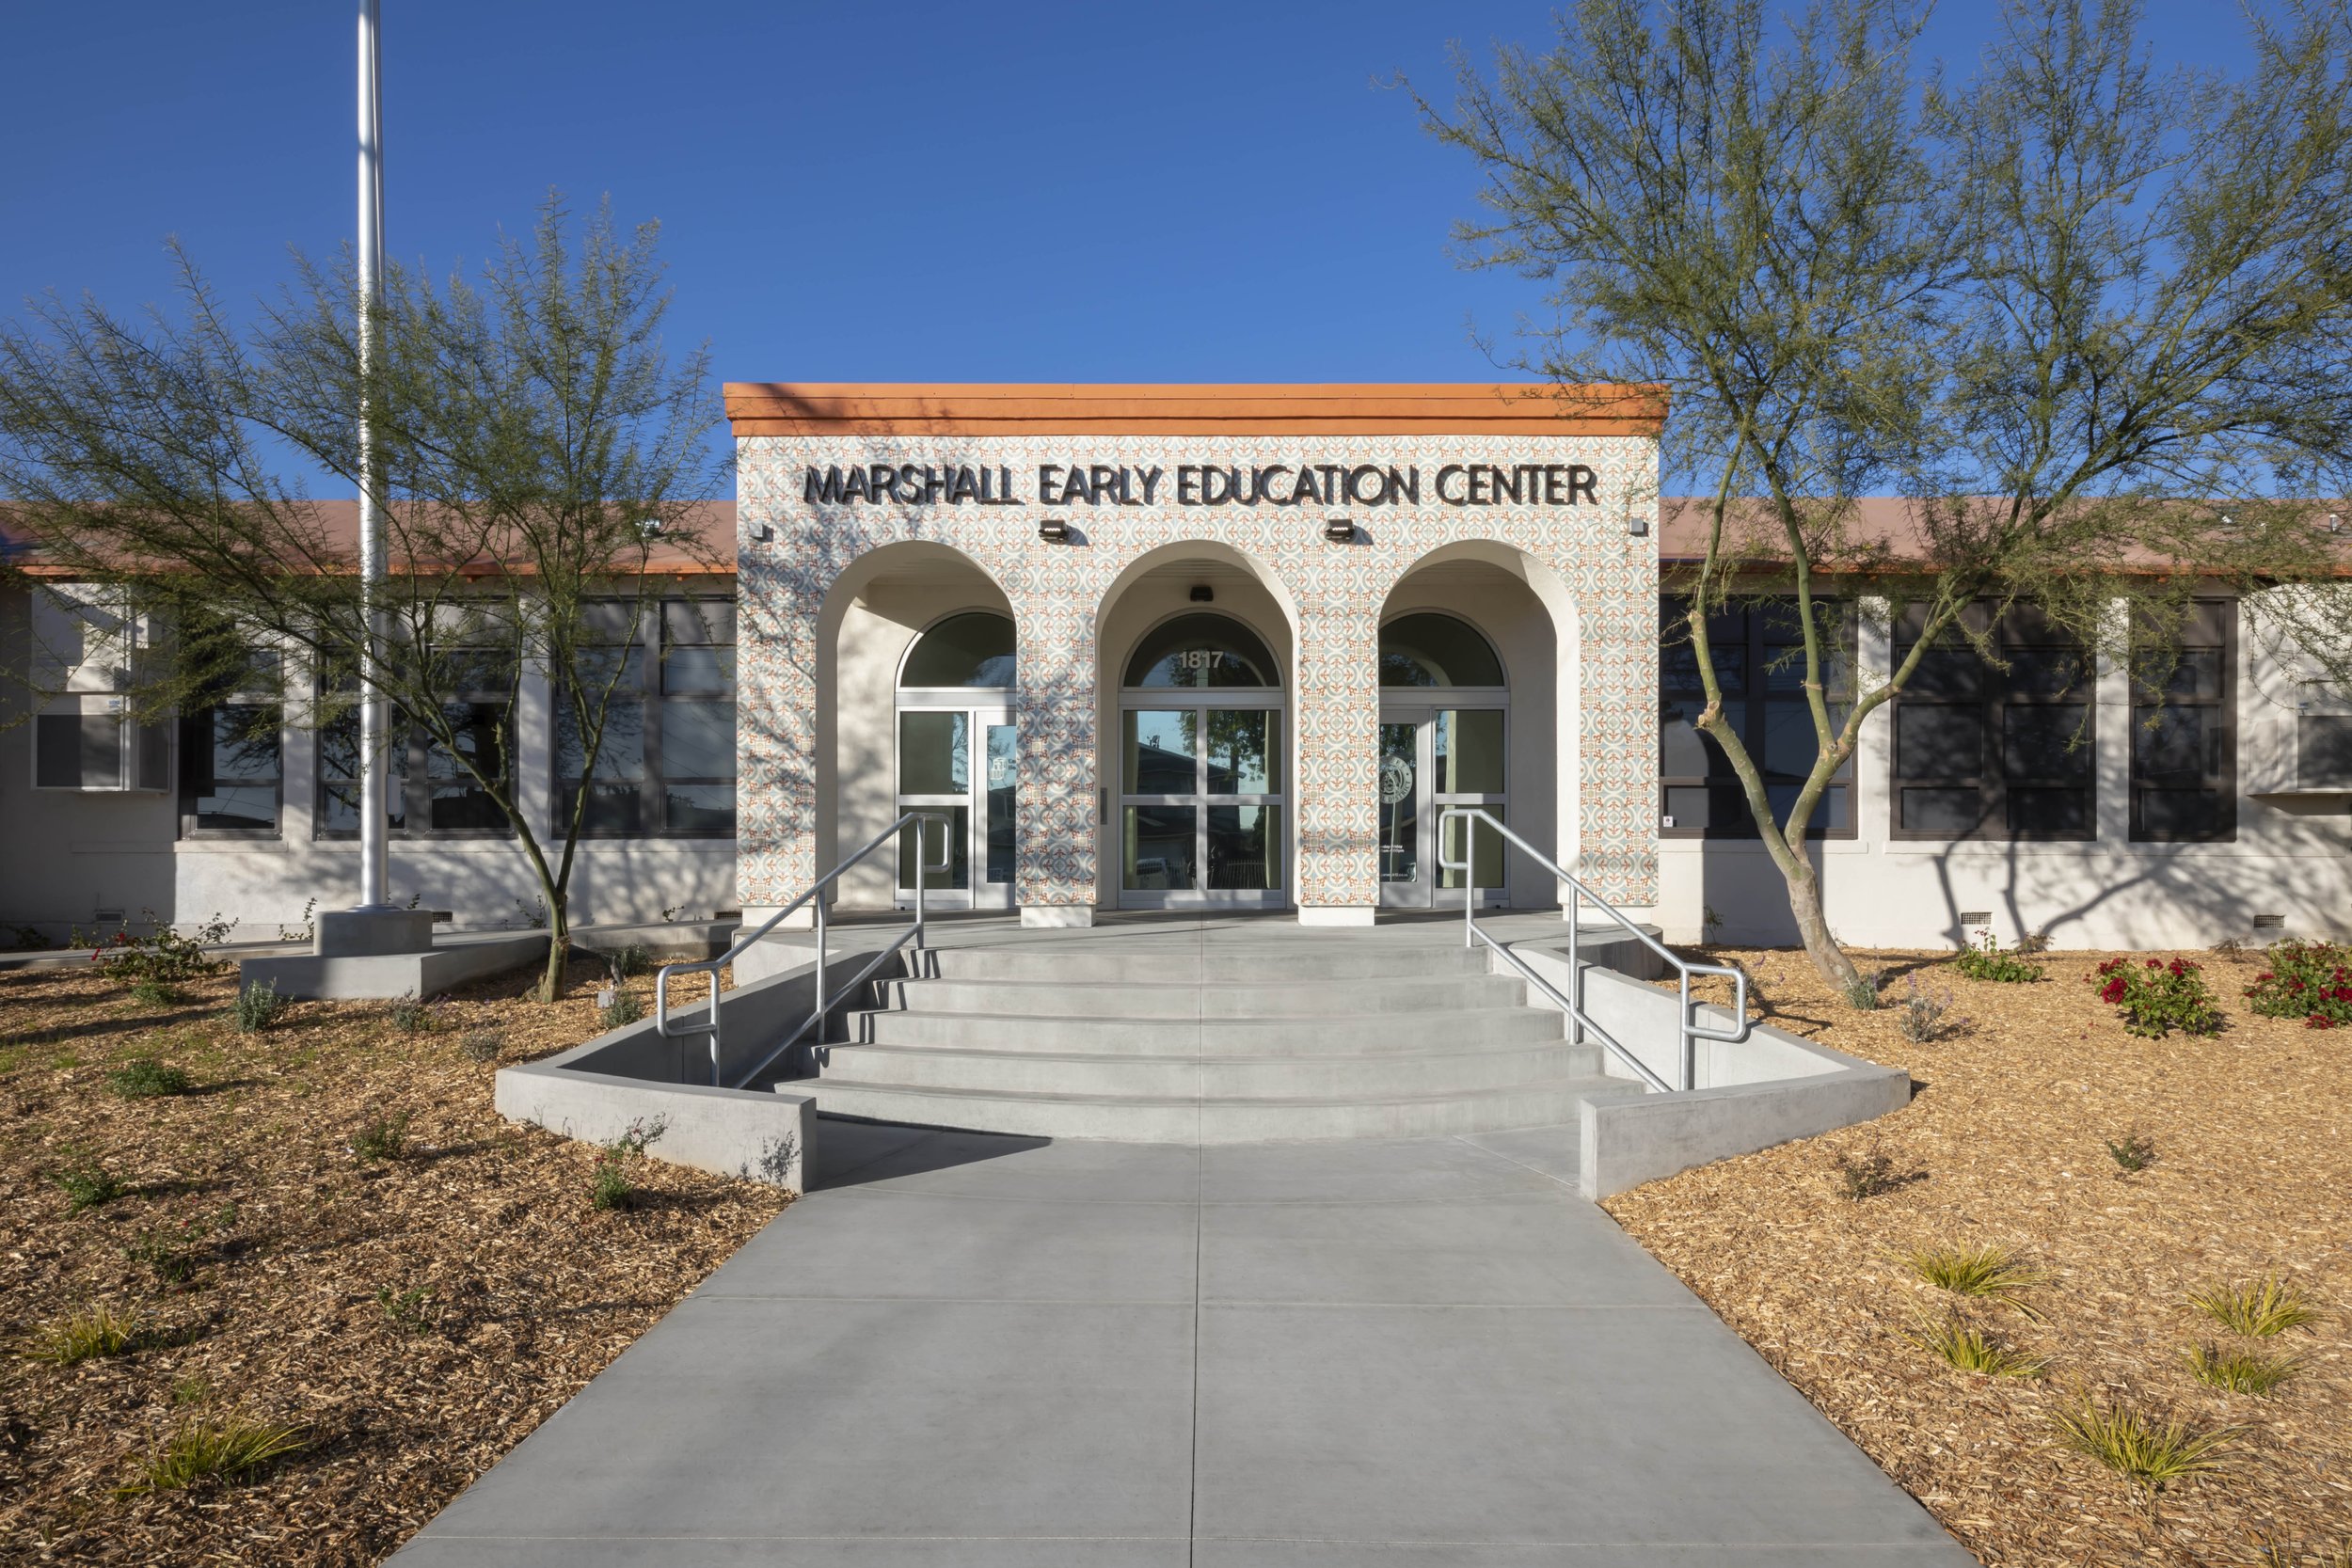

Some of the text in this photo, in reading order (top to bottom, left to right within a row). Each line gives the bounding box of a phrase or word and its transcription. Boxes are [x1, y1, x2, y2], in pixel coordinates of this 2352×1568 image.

[803, 464, 1598, 506] MARSHALL EARLY EDUCATION CENTER
[1179, 651, 1224, 668] 1817
